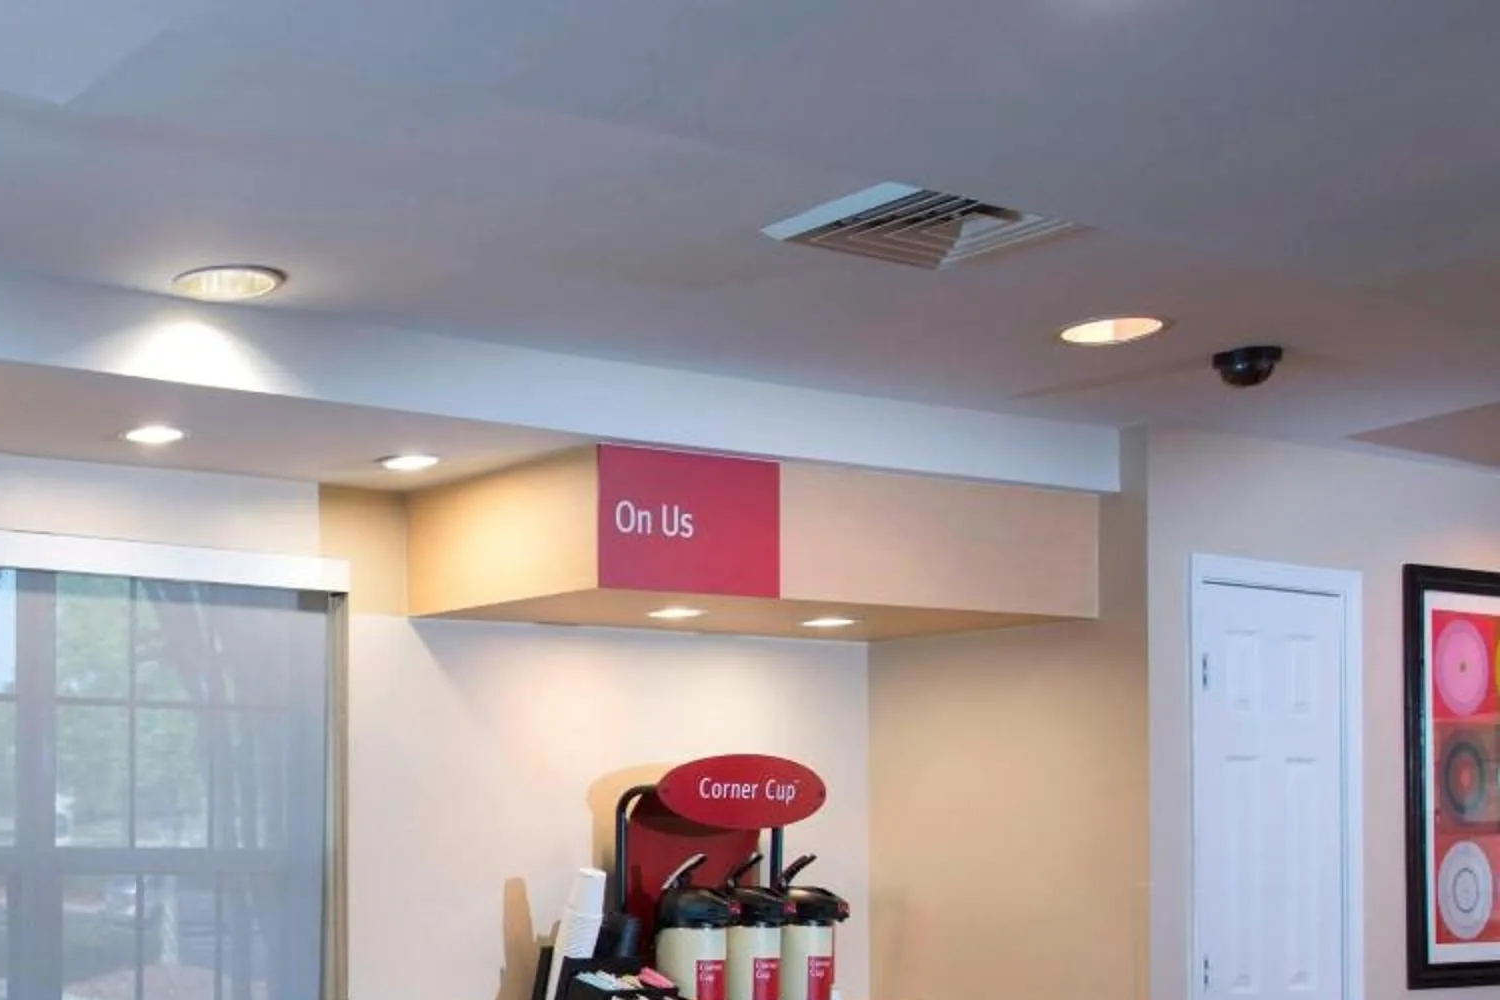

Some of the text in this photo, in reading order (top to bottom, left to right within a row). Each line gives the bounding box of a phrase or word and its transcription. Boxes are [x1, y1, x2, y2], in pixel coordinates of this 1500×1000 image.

[615, 500, 693, 538] On Us
[699, 777, 796, 806] Corner Cup
